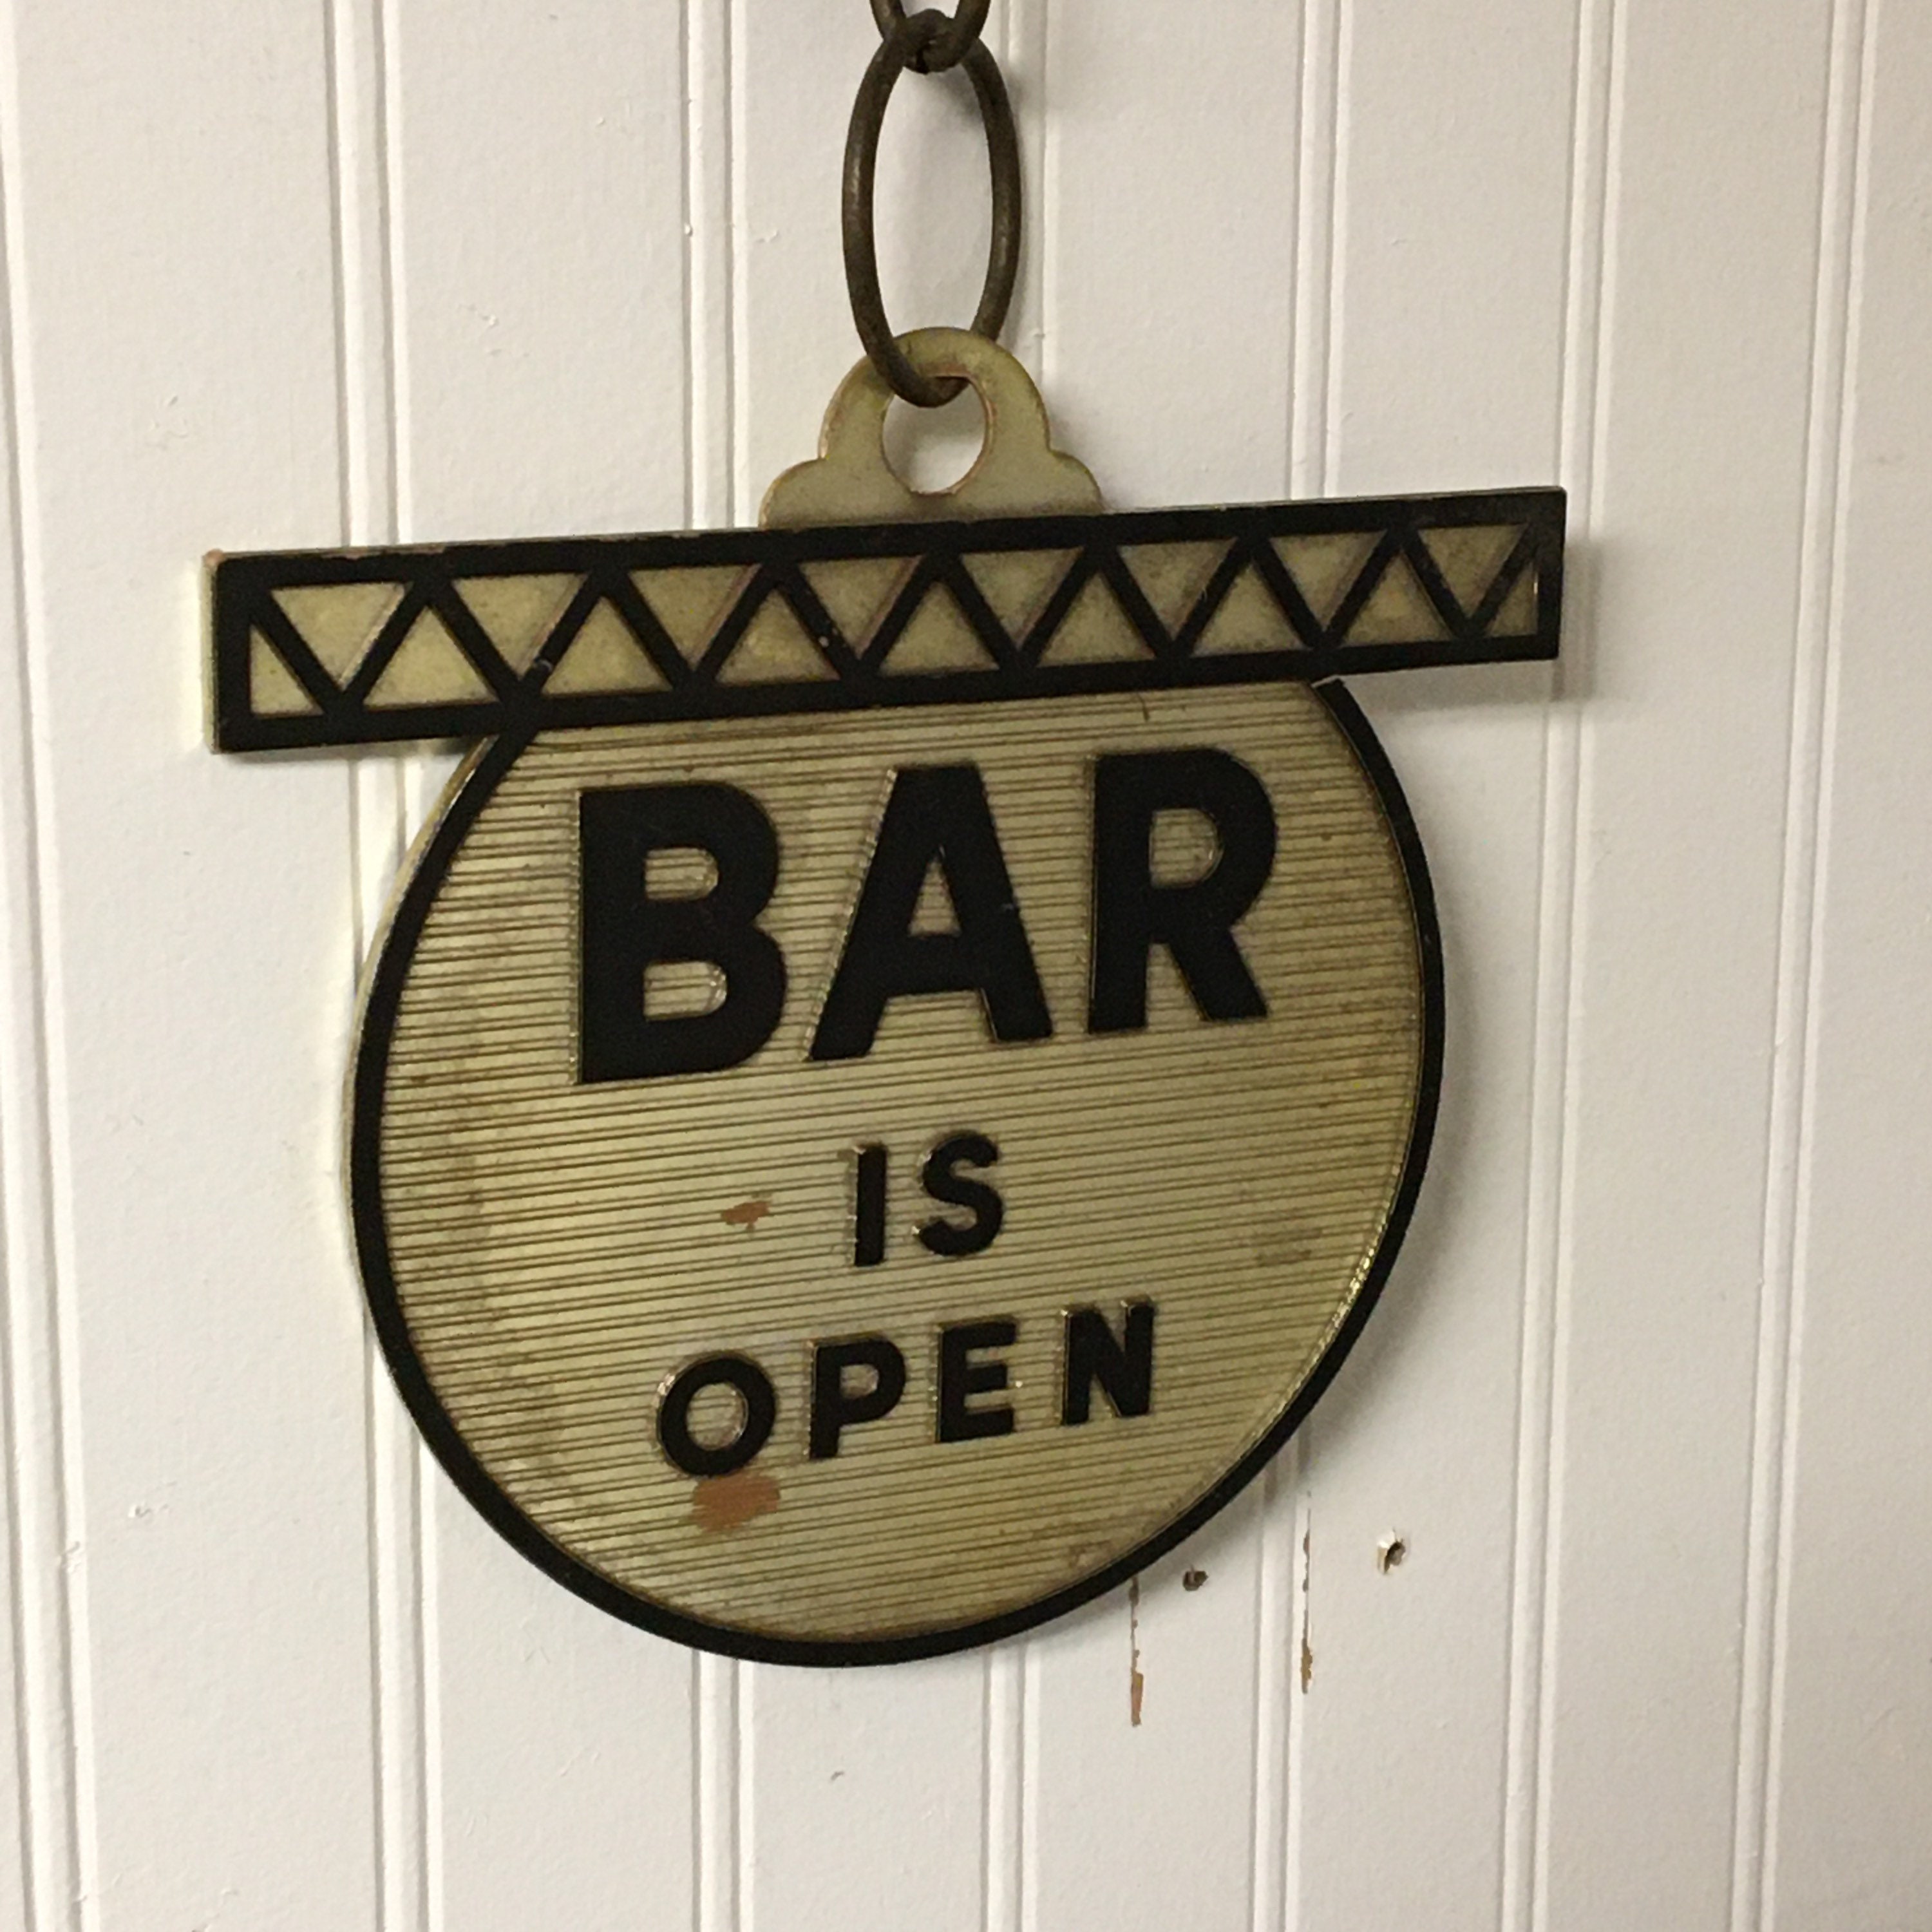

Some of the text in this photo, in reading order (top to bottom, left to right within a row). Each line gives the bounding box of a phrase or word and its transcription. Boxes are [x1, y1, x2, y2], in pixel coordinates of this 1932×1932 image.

[574, 744, 1280, 1086] BAR
[853, 1130, 1005, 1267] IS
[656, 1296, 1157, 1481] OPEN
